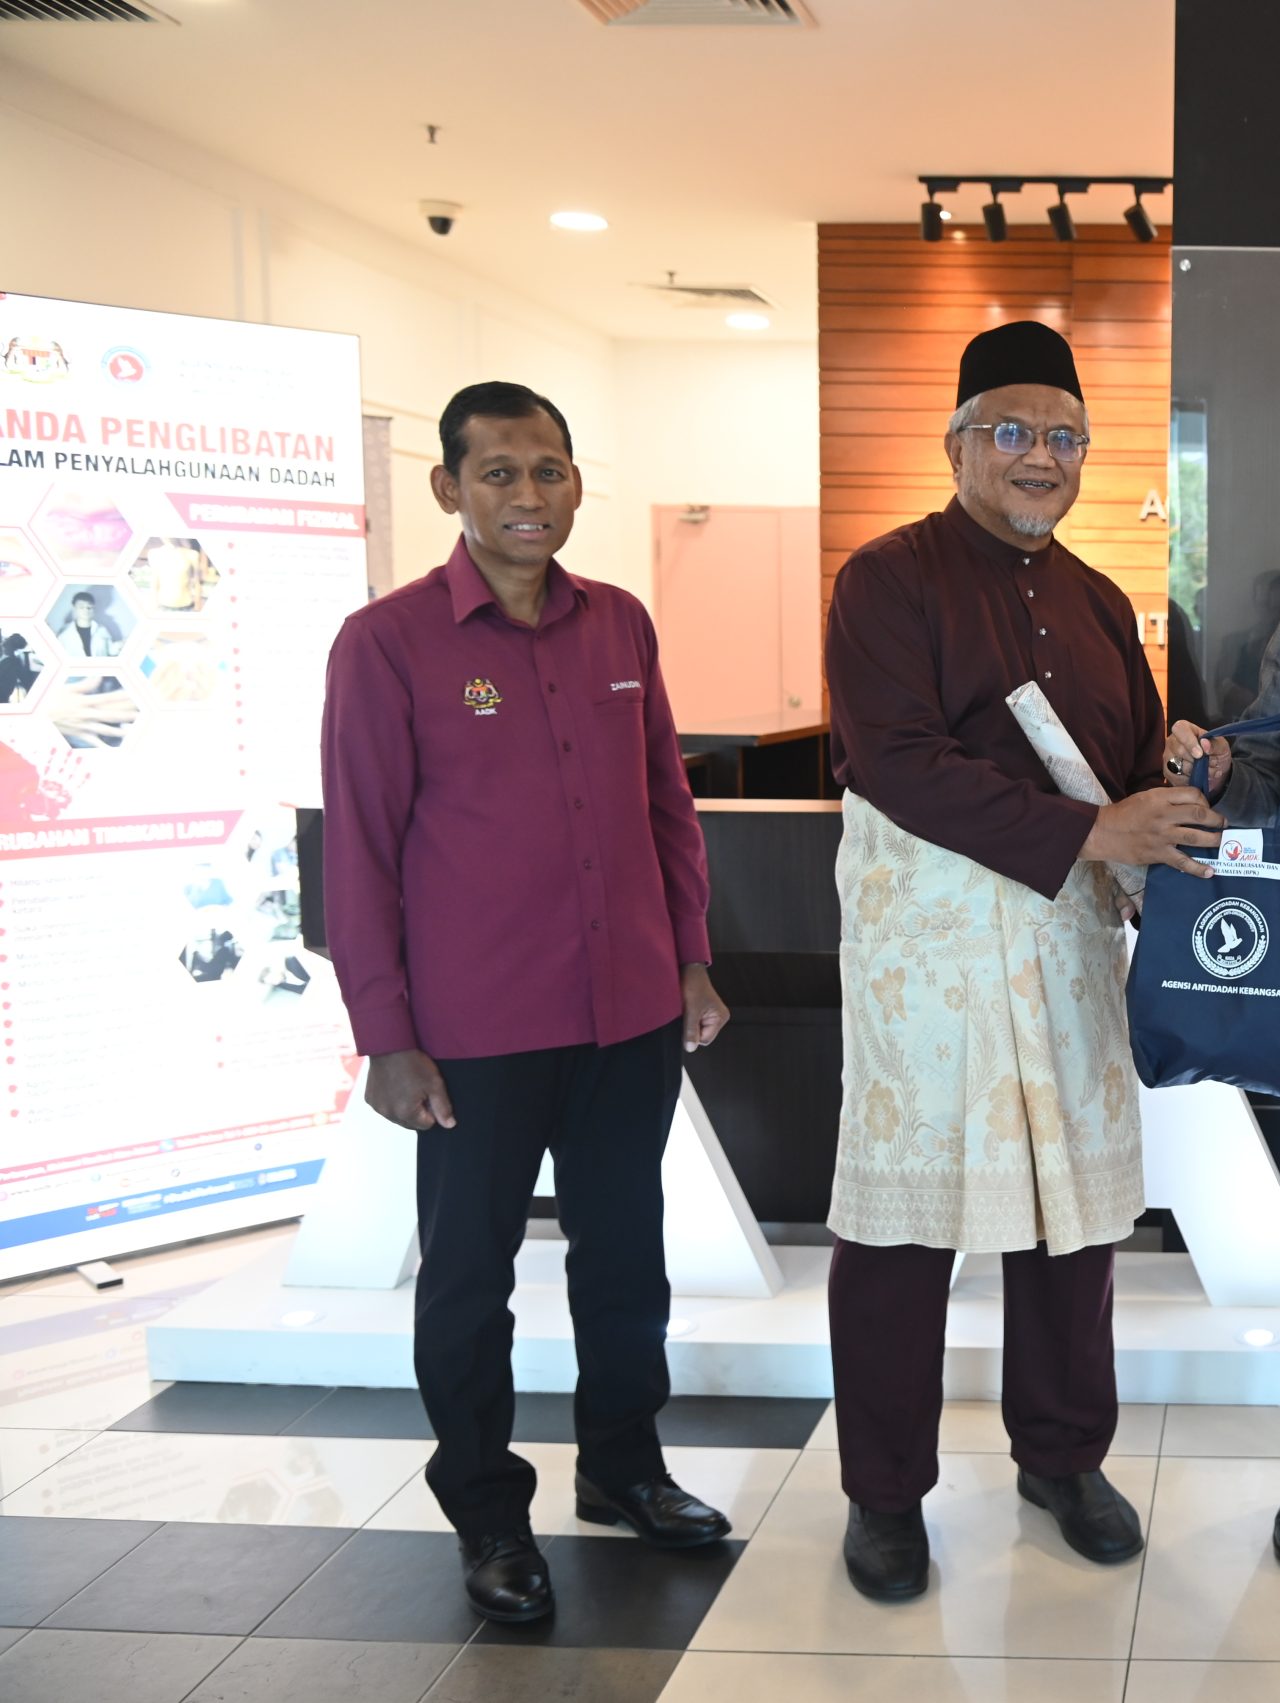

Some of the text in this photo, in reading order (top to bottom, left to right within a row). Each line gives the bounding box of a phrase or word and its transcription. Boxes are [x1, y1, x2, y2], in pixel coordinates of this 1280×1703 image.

[0, 409, 335, 462] NDA PENGLIBATAN
[55, 452, 260, 482] PENYALAHGUNAAN
[269, 467, 336, 487] DADAH
[1161, 979, 1192, 990] AGENSI
[1192, 983, 1238, 994] ANTIDADAH
